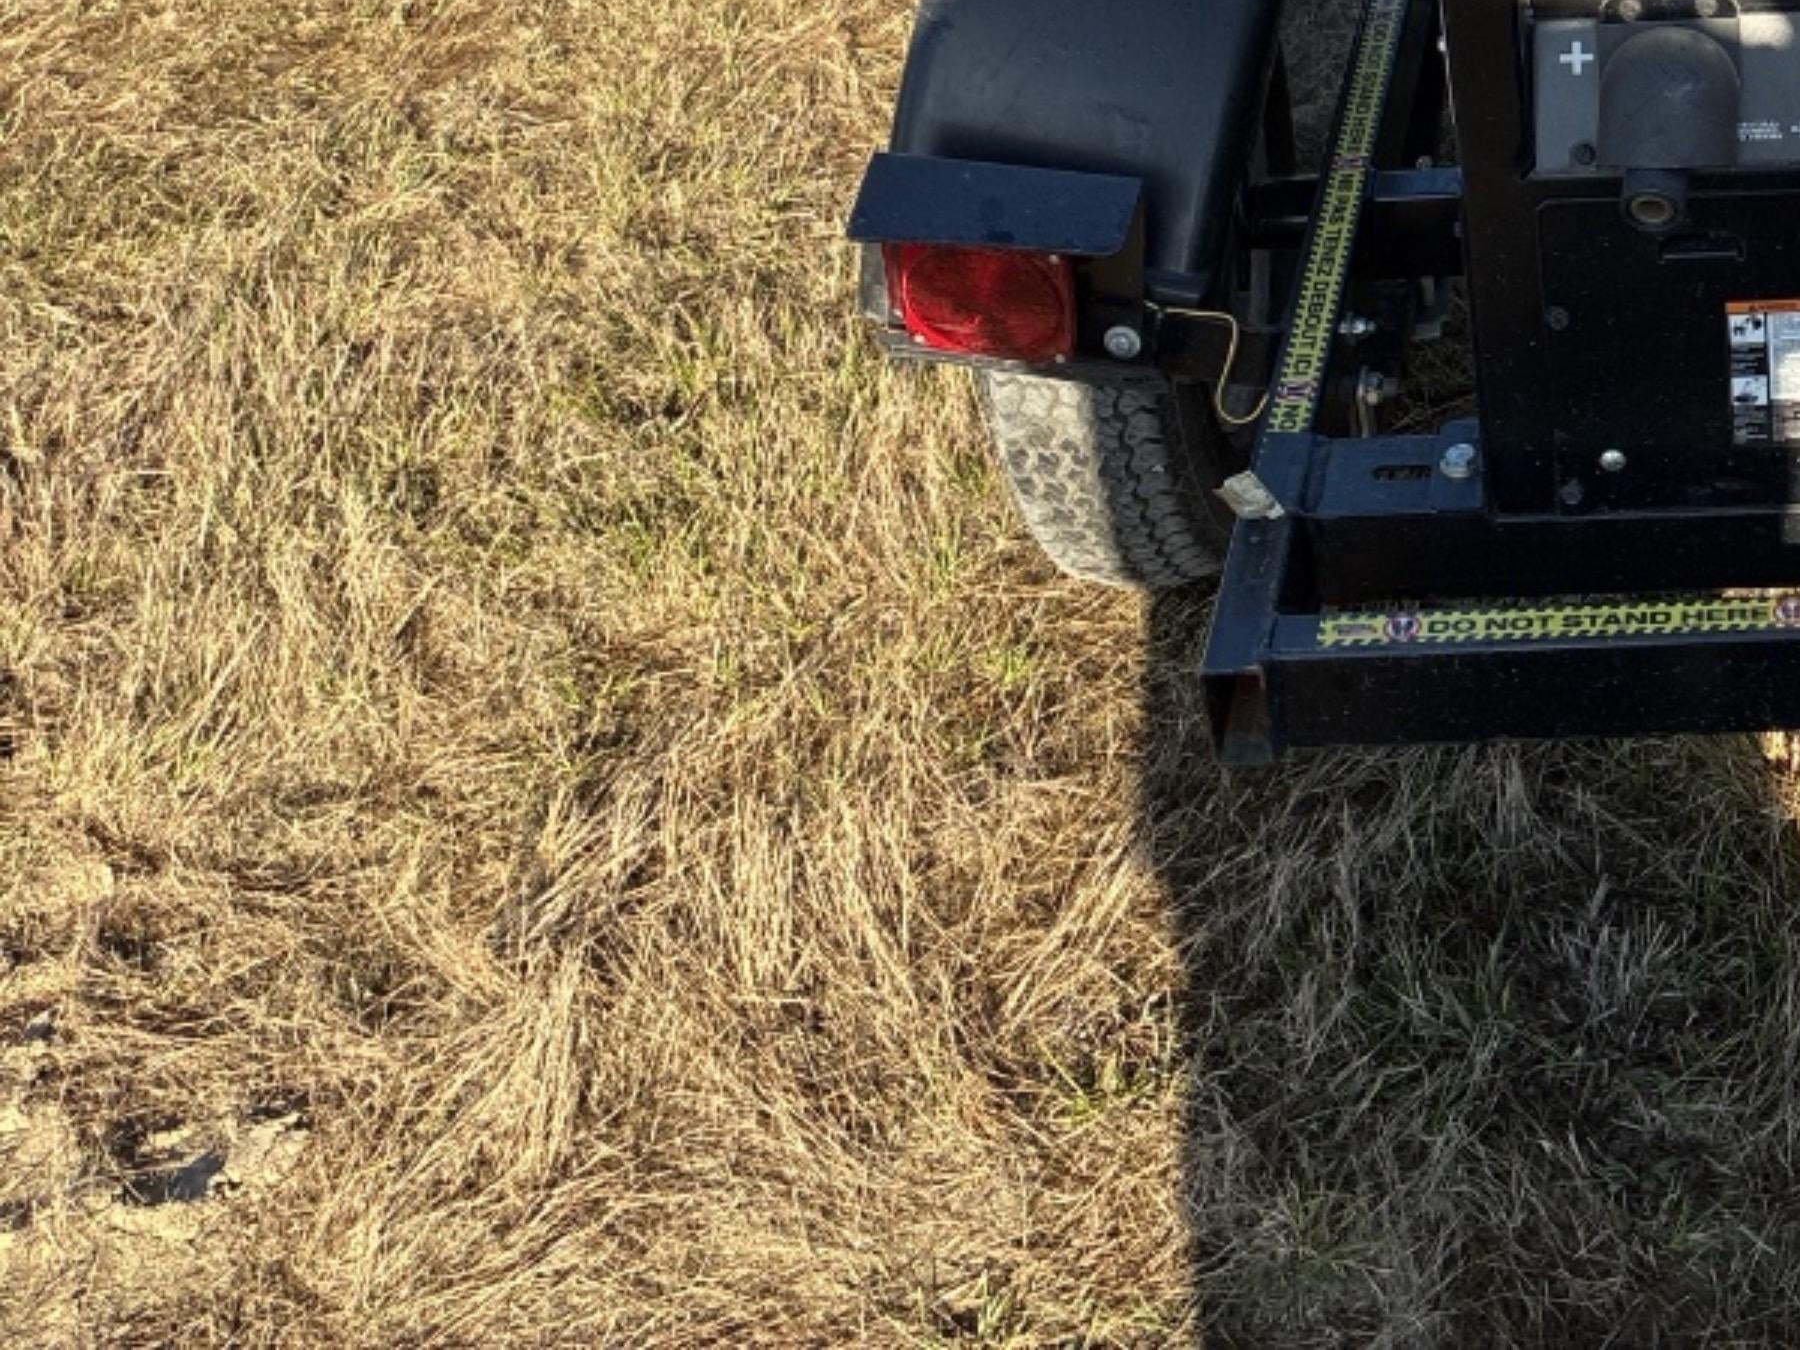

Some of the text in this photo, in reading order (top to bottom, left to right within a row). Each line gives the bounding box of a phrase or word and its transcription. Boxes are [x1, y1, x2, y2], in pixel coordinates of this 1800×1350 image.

[1300, 280, 1329, 349] DEBOUT
[1279, 403, 1302, 430] NO
[1426, 607, 1769, 633] DO NOT STAND HERE
